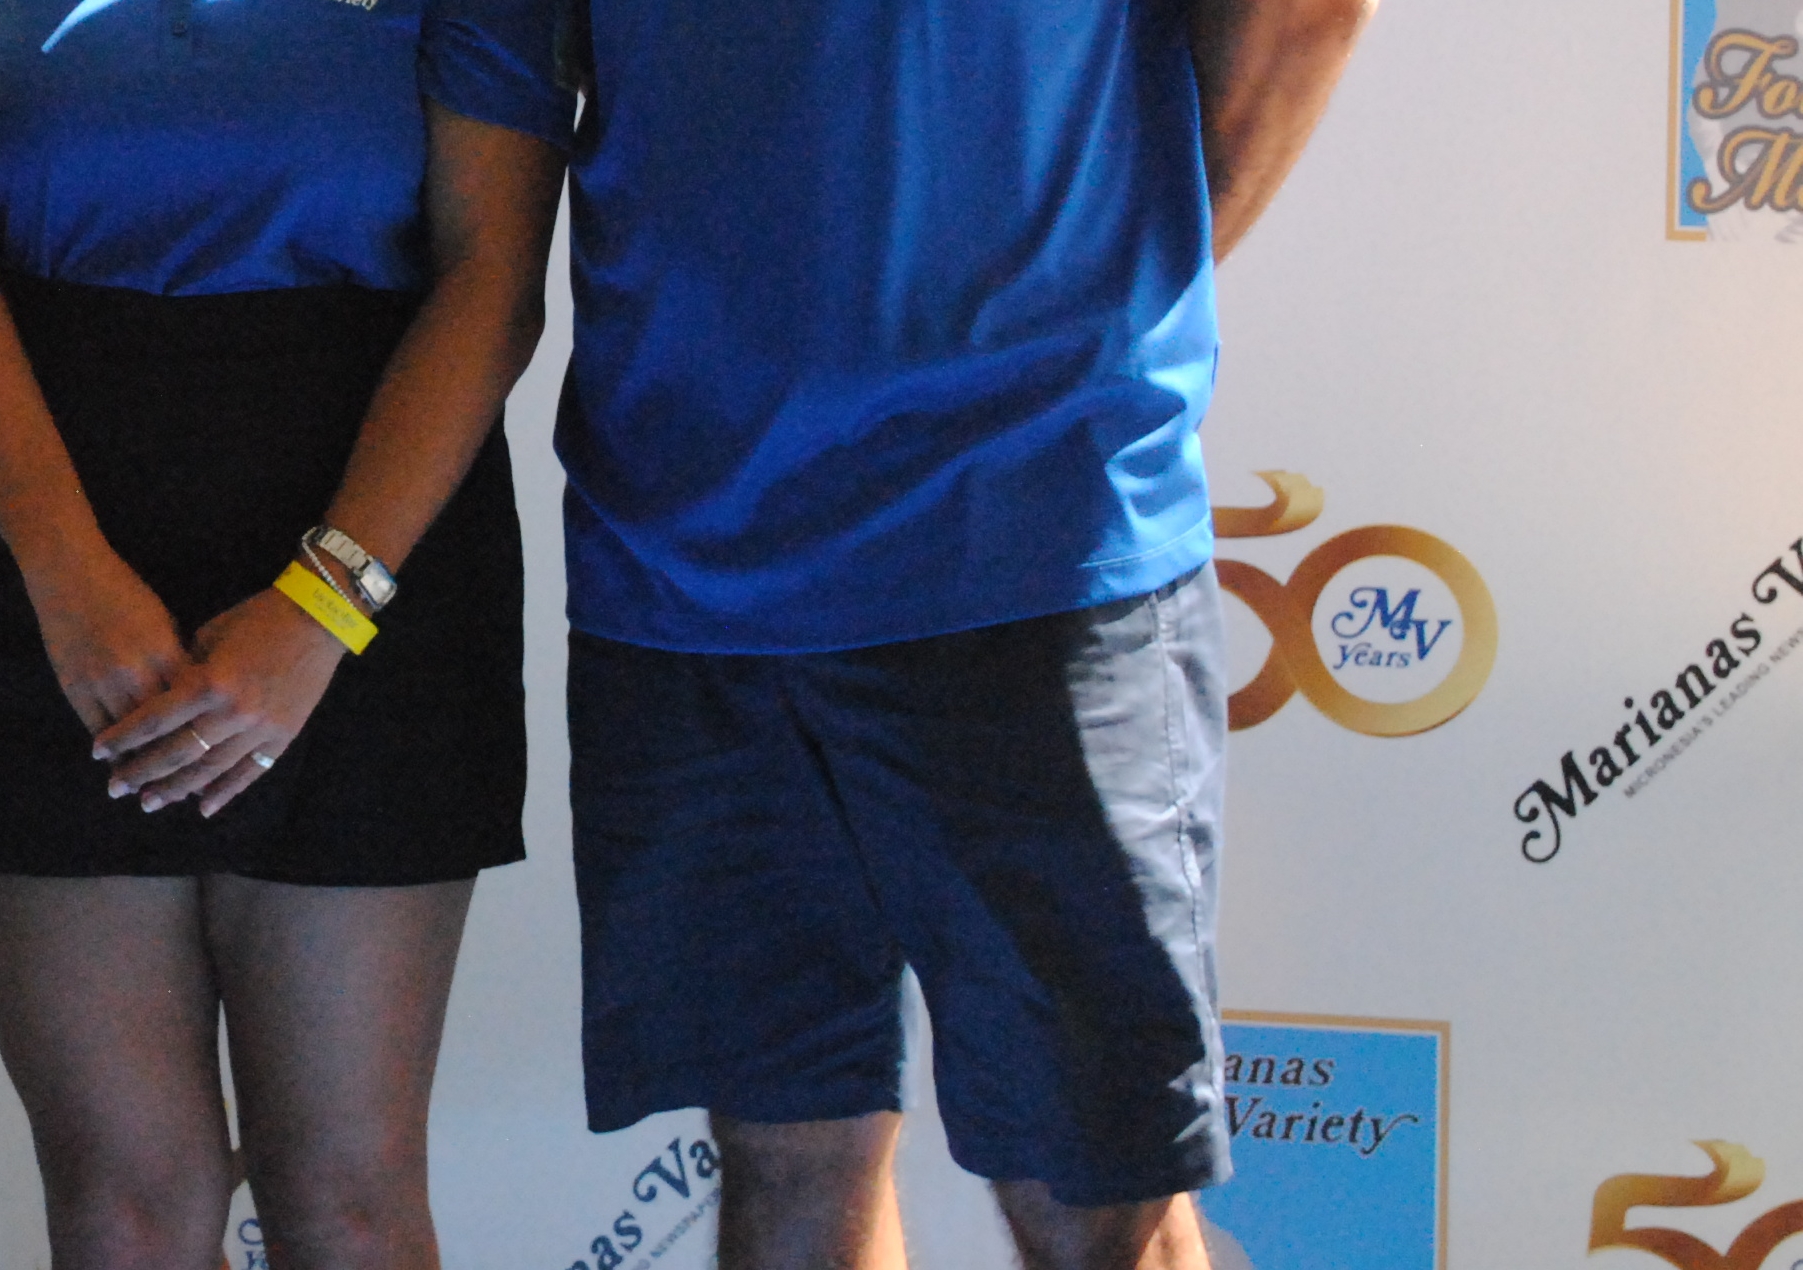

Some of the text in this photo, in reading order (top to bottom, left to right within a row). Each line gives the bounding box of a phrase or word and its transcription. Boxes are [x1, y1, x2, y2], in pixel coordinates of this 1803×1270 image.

[1334, 642, 1410, 670] years
[1514, 612, 1762, 863] Marianas
[1623, 662, 1770, 799] MICRONESIA'S LEADING
[1222, 1052, 1335, 1087] anas
[1224, 1095, 1417, 1156] Variety
